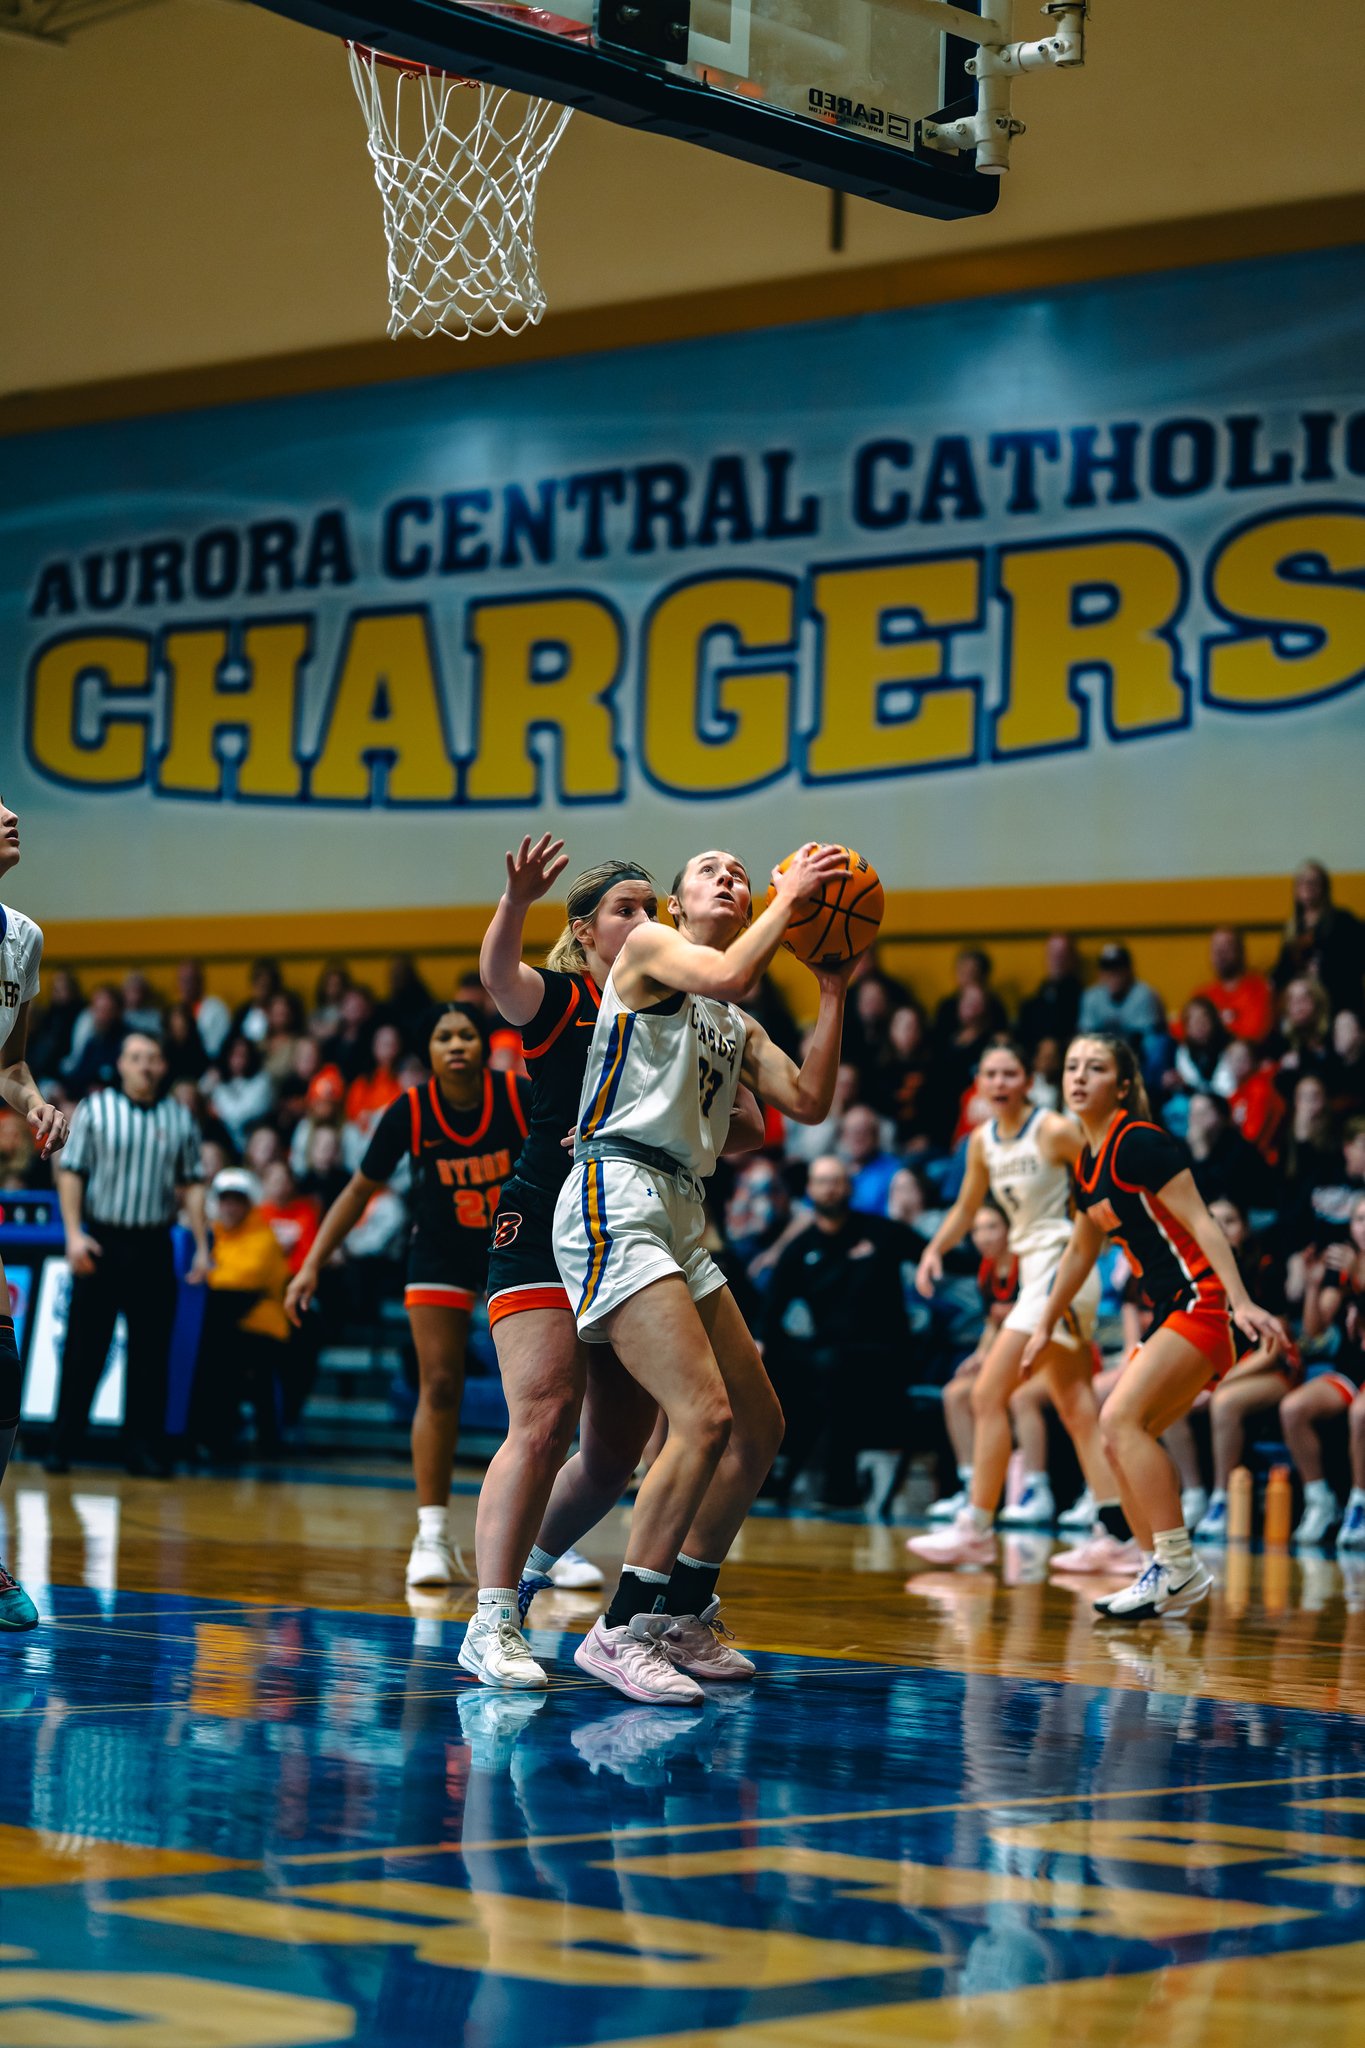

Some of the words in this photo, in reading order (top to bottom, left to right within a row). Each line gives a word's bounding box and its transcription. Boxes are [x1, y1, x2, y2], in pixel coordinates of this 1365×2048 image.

[27, 508, 356, 618] AURORA
[380, 449, 820, 580] CENTRAL
[25, 501, 1365, 809] CHARGERS
